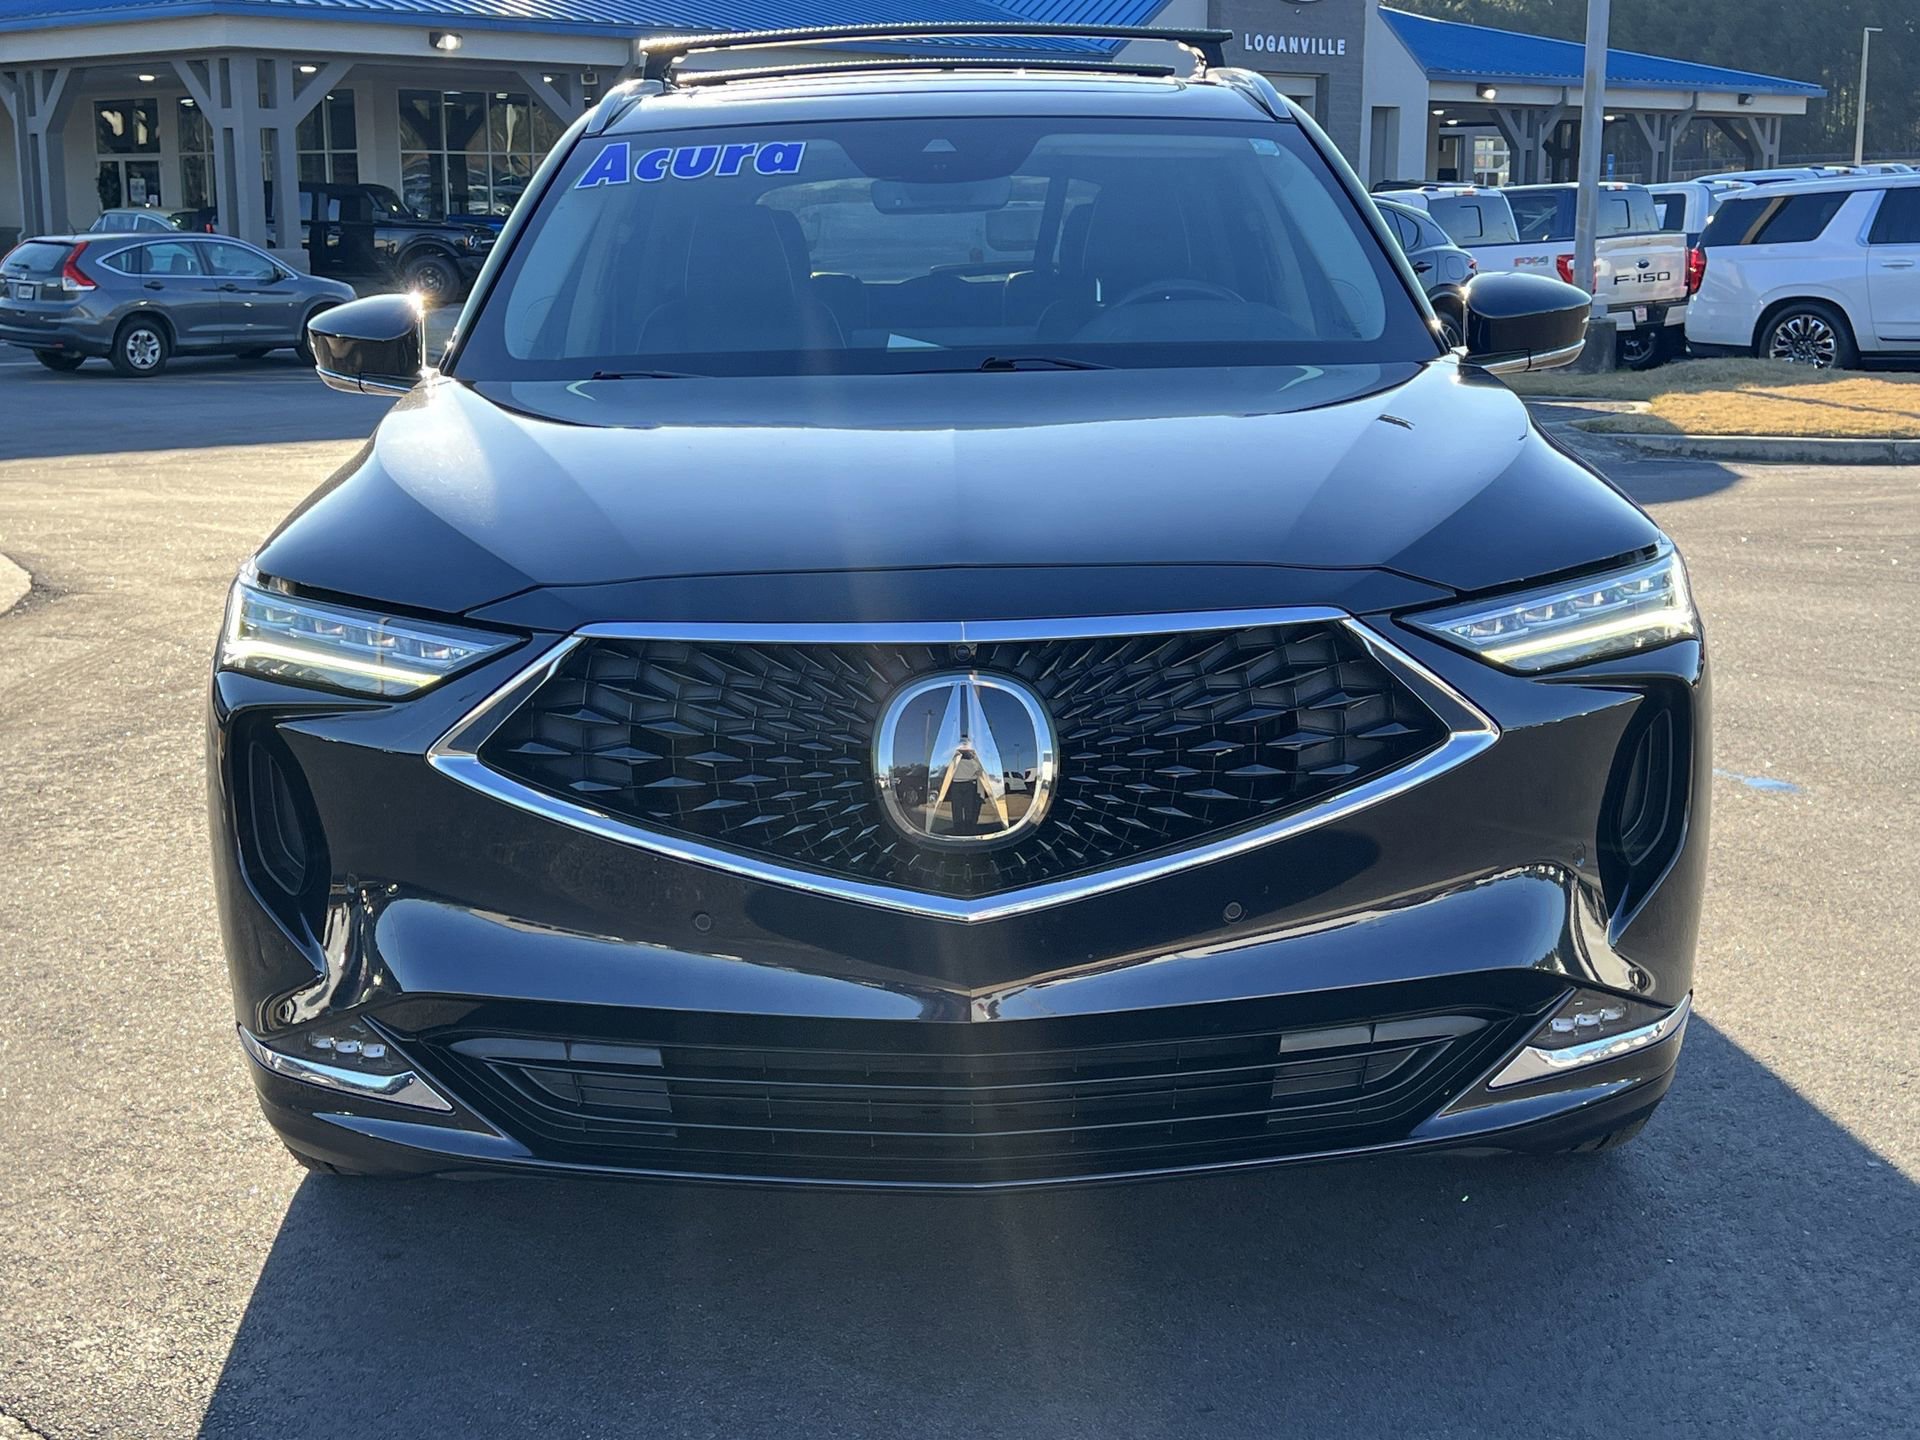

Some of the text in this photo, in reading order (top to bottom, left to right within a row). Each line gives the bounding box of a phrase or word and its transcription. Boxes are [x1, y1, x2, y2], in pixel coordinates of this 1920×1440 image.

[1244, 33, 1346, 55] LOGANVILLE
[574, 142, 806, 189] Acura
[1514, 255, 1549, 267] FX4
[1613, 271, 1671, 286] F-150
